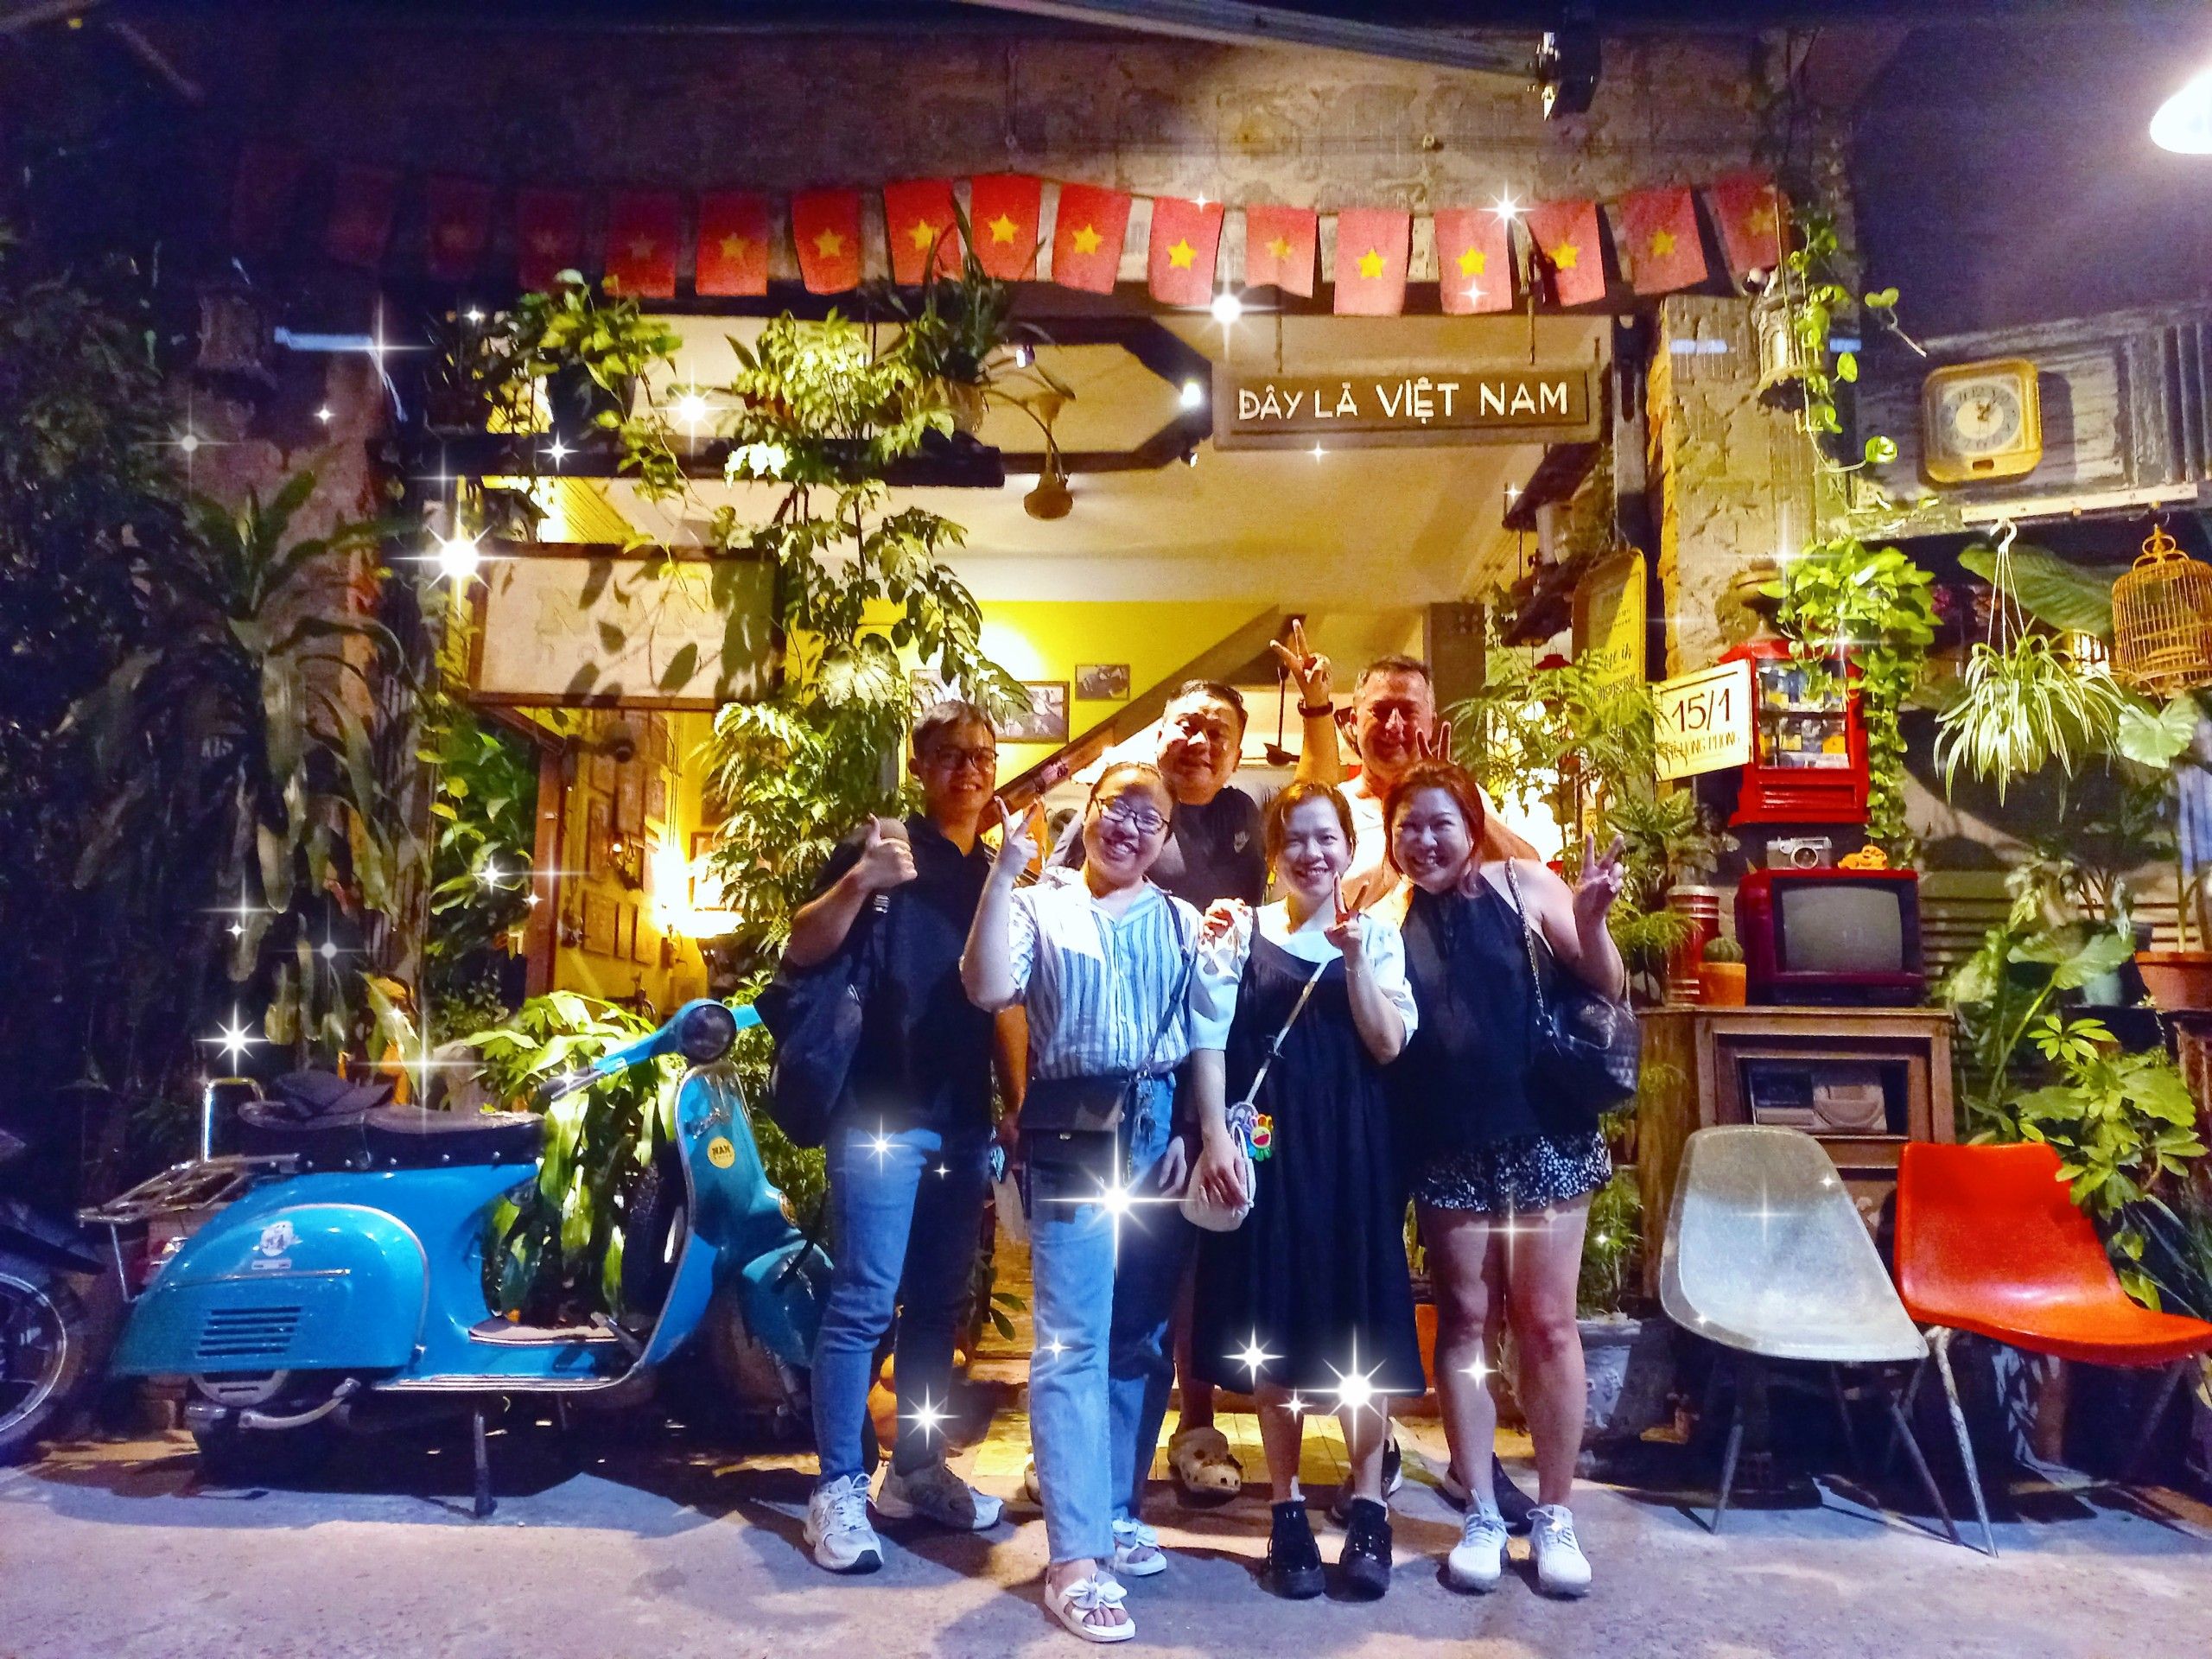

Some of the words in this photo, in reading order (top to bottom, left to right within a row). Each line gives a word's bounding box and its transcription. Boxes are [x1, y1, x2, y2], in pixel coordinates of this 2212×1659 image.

[1238, 384, 1303, 421] ĐÂY
[1376, 377, 1460, 424] VIỆT
[1479, 381, 1568, 416] NAM
[1671, 688, 1730, 734] 15/1
